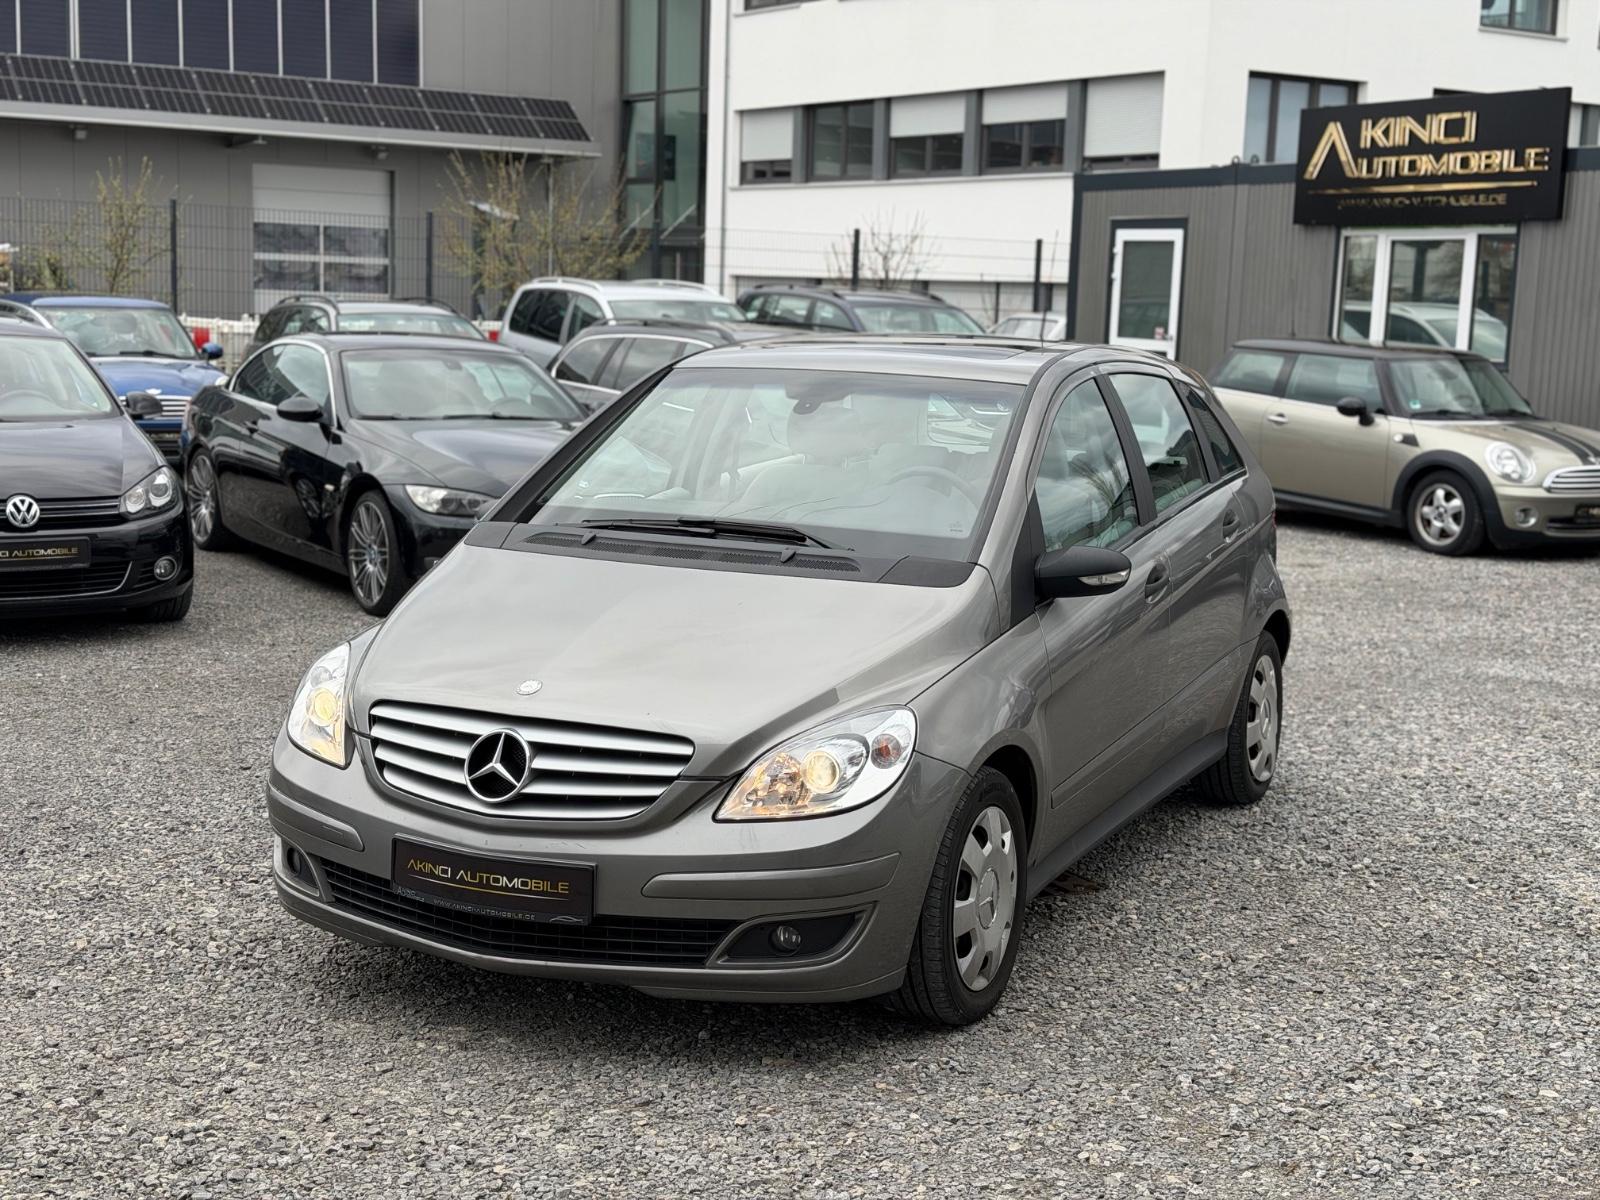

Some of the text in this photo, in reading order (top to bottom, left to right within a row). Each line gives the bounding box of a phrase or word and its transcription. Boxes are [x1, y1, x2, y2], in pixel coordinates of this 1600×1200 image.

[12, 547, 79, 557] AUTOMOBILE
[407, 858, 570, 895] AKINCI AUTOMOBILE
